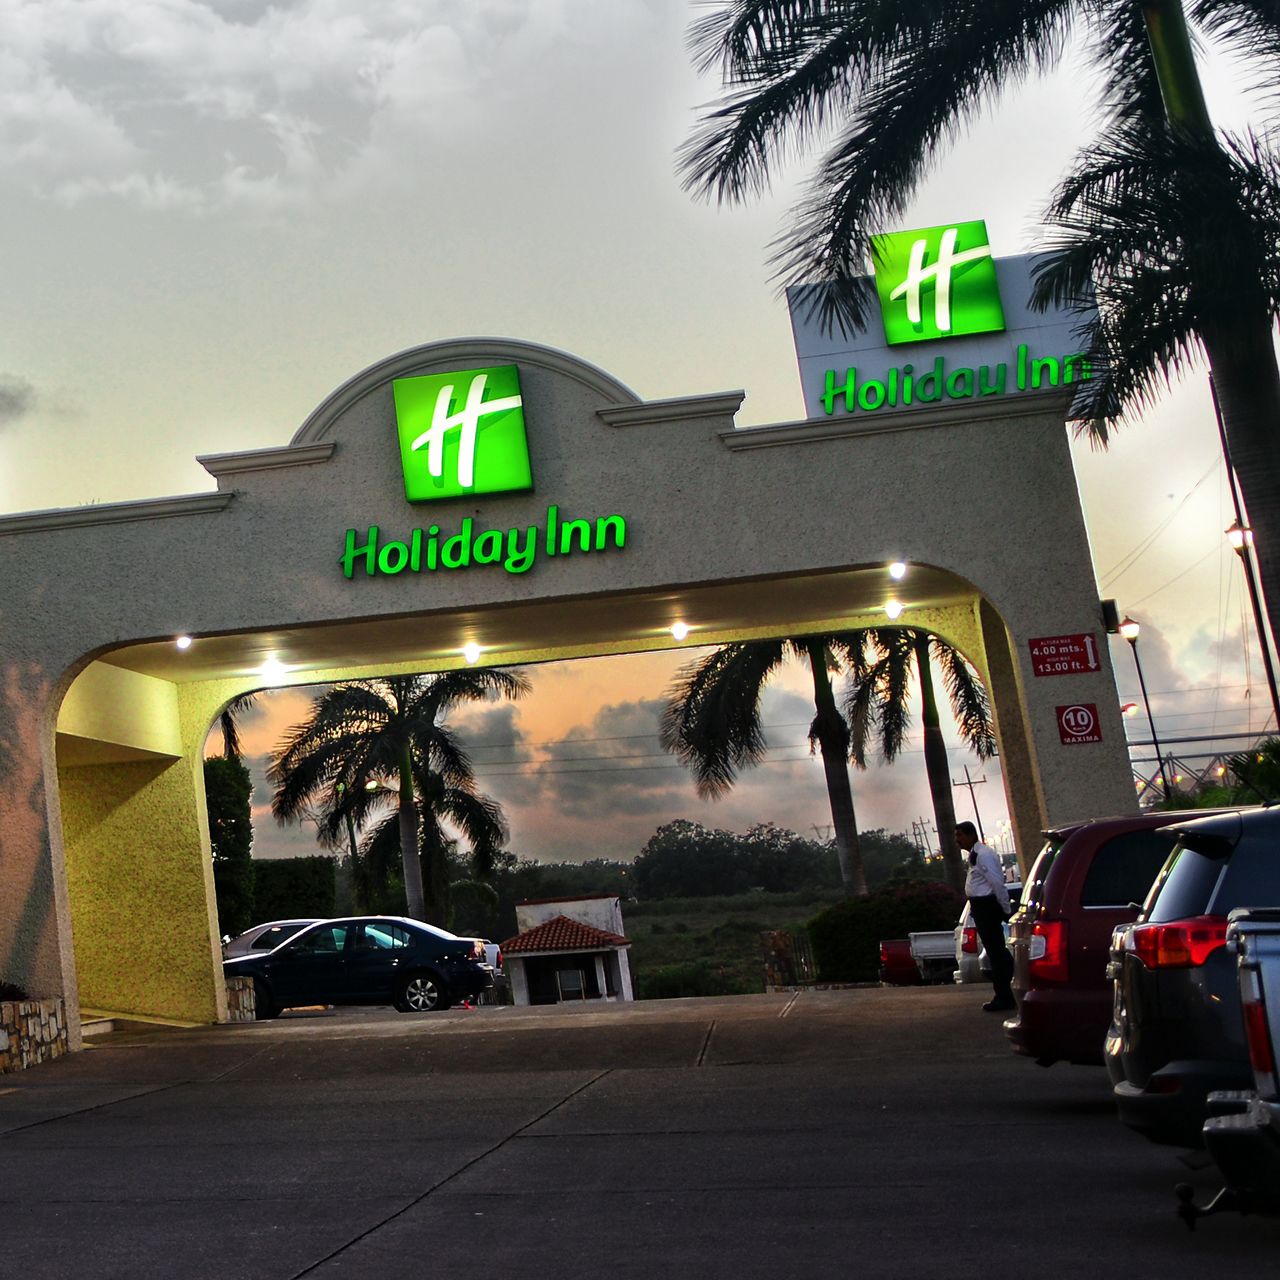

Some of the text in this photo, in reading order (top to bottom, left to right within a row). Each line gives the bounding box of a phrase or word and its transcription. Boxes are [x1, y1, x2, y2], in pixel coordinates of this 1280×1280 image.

[820, 356, 1007, 415] Holiday
[338, 505, 627, 580] Holiday Inn
[1032, 645, 1084, 655] 4.00 mts.
[1038, 661, 1084, 672] 13.00 ft.
[1066, 711, 1089, 726] 10
[1063, 735, 1100, 743] MAXIMA
